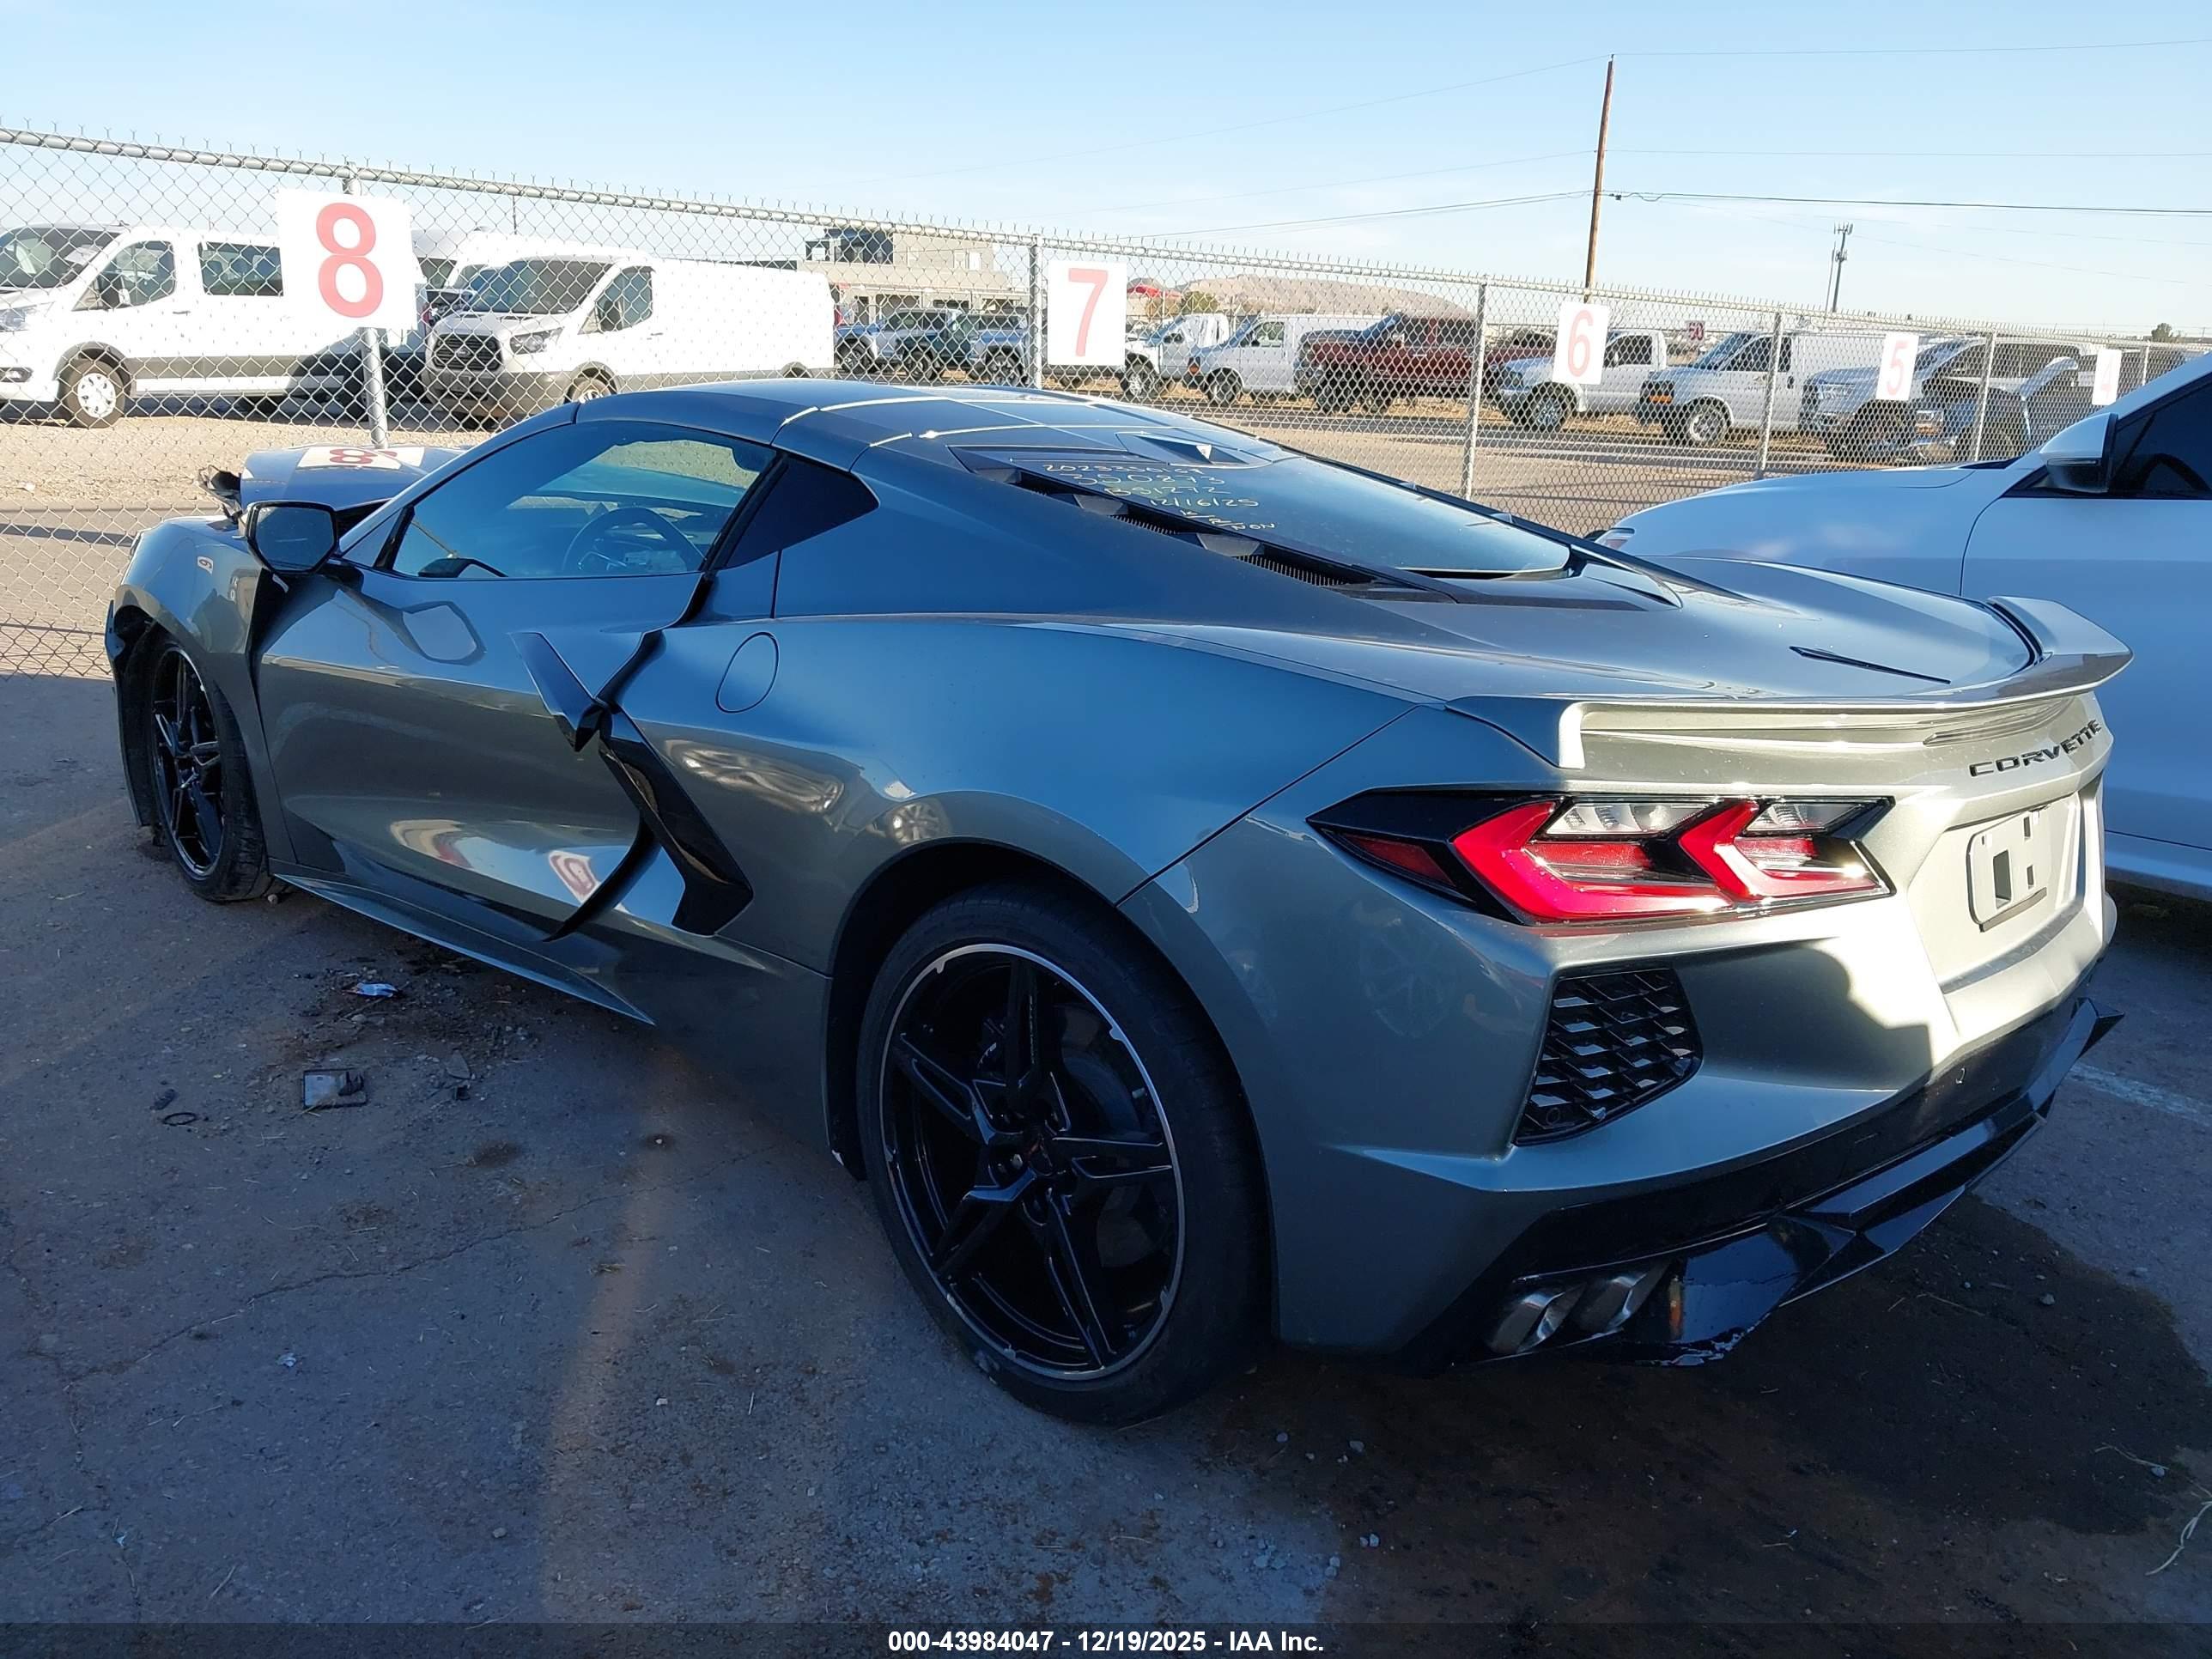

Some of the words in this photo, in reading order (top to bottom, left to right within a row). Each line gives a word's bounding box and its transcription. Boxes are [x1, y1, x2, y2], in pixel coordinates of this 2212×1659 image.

[315, 202, 384, 319] 8
[1068, 267, 1109, 357] 7
[1567, 309, 1594, 378] 6
[1886, 339, 1909, 396] 5
[1969, 719, 2102, 777] CORVETTE
